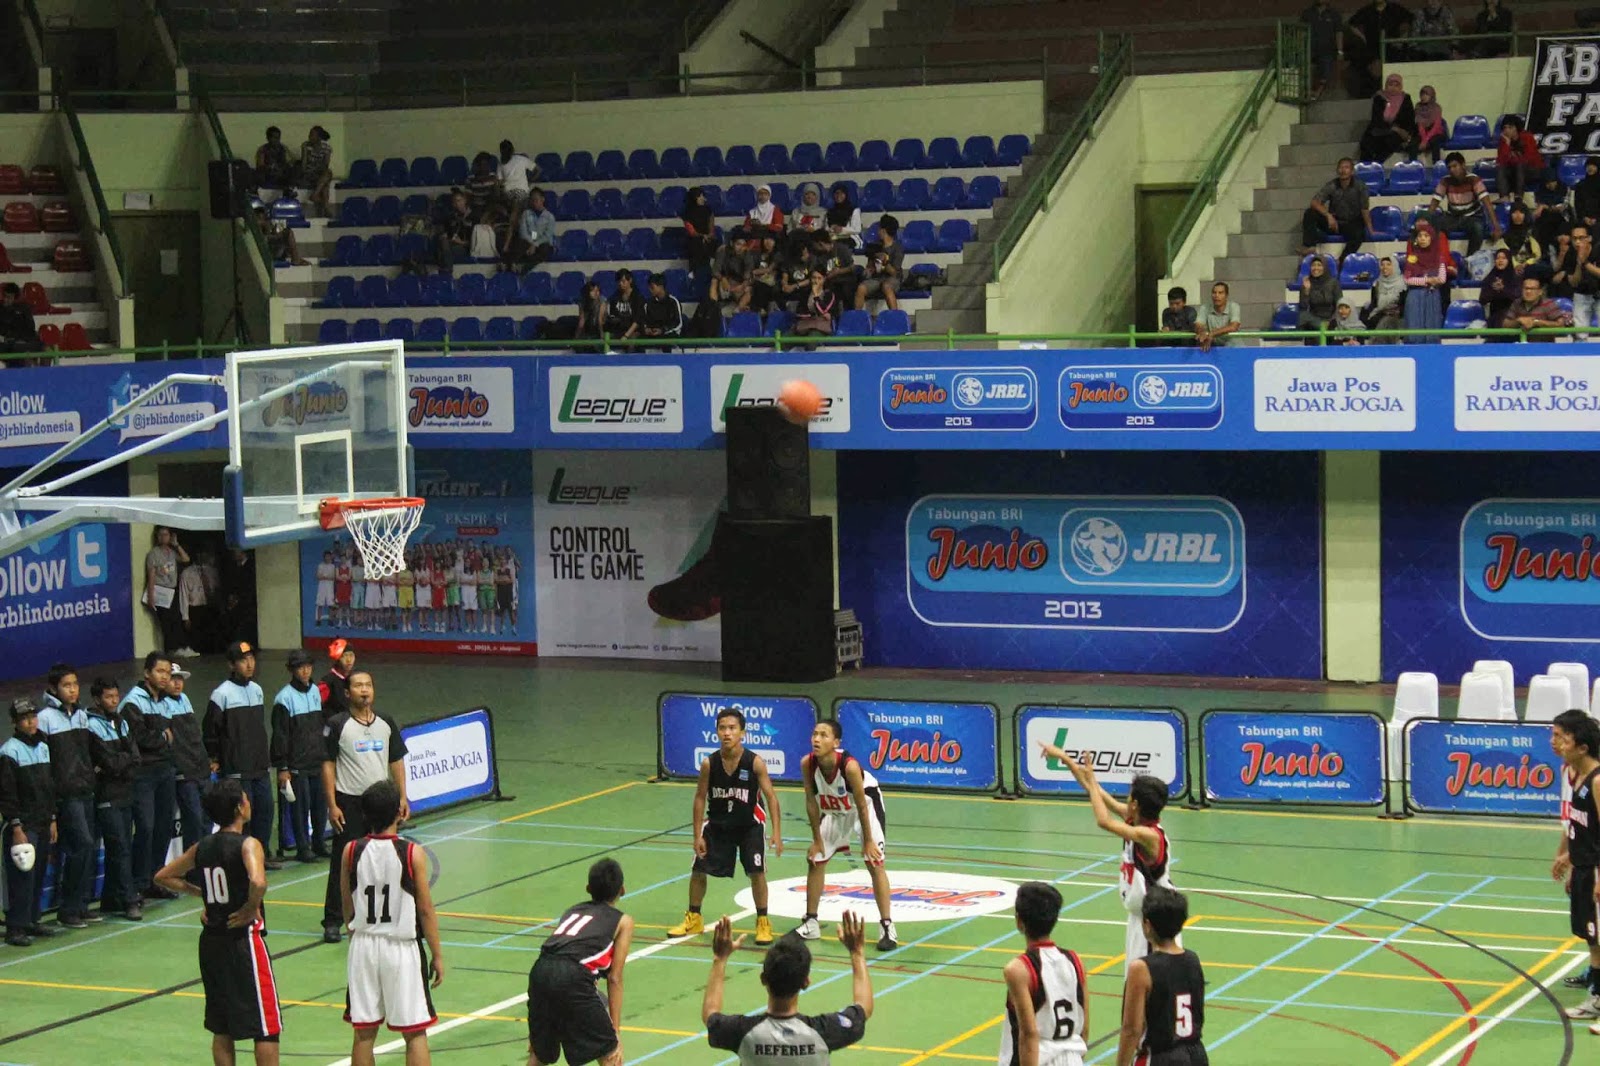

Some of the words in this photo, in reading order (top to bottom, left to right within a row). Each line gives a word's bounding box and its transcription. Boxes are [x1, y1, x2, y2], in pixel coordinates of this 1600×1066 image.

[409, 374, 454, 384] Tabungan
[457, 374, 472, 382] BRI
[890, 374, 923, 383] Tabungan
[1069, 372, 1103, 381] Tabungan
[1288, 378, 1337, 392] Jawa
[1345, 378, 1380, 392] Pos
[1490, 376, 1543, 391] Jawa
[1550, 375, 1588, 391] Pos
[890, 383, 947, 410] Junio
[986, 384, 1027, 399] JRBL
[1069, 381, 1129, 409] Junio
[1169, 382, 1212, 397] JRBL
[0, 390, 46, 415] ollow.
[409, 386, 489, 427] Junio
[558, 374, 667, 423] League
[1265, 396, 1337, 412] RADAR
[1340, 396, 1404, 412] JOGJA
[1466, 395, 1541, 411] RADAR
[1545, 395, 1600, 411] JOGJ
[945, 417, 972, 426] 2013
[1126, 416, 1155, 425] 2013
[548, 468, 631, 505] League
[927, 508, 996, 522] Tabungan
[1001, 508, 1023, 520] BRI
[1485, 513, 1565, 528] Tabungan
[1571, 514, 1597, 526] BRI
[550, 526, 636, 553] CONTROL
[1132, 533, 1222, 563] JRBL
[926, 527, 1048, 581] Junio
[549, 553, 585, 580] THE
[591, 553, 645, 581] GAME
[1045, 601, 1102, 618] 2013
[868, 712, 922, 725] Tabungan
[926, 715, 944, 725] BRI
[702, 731, 719, 743] Yo
[740, 731, 775, 745] ollow.
[1238, 725, 1299, 738] Tabungan
[1303, 726, 1322, 737] BRI
[870, 729, 962, 770] Junio
[1046, 728, 1151, 772] League
[1445, 734, 1508, 749] Tabungan
[1512, 737, 1533, 747] BRI
[409, 753, 424, 762] Jawa
[425, 750, 436, 758] Pos
[1241, 742, 1344, 785] Junio
[410, 759, 449, 781] RADAR
[450, 751, 483, 770] JOGJA
[1446, 752, 1554, 796] Junio
[754, 853, 762, 866] 8
[203, 867, 229, 904] 10
[364, 884, 392, 924] 11
[553, 913, 594, 936] 11
[1052, 999, 1075, 1041] 6
[1175, 994, 1193, 1038] 5
[754, 1044, 816, 1056] REFEREE
